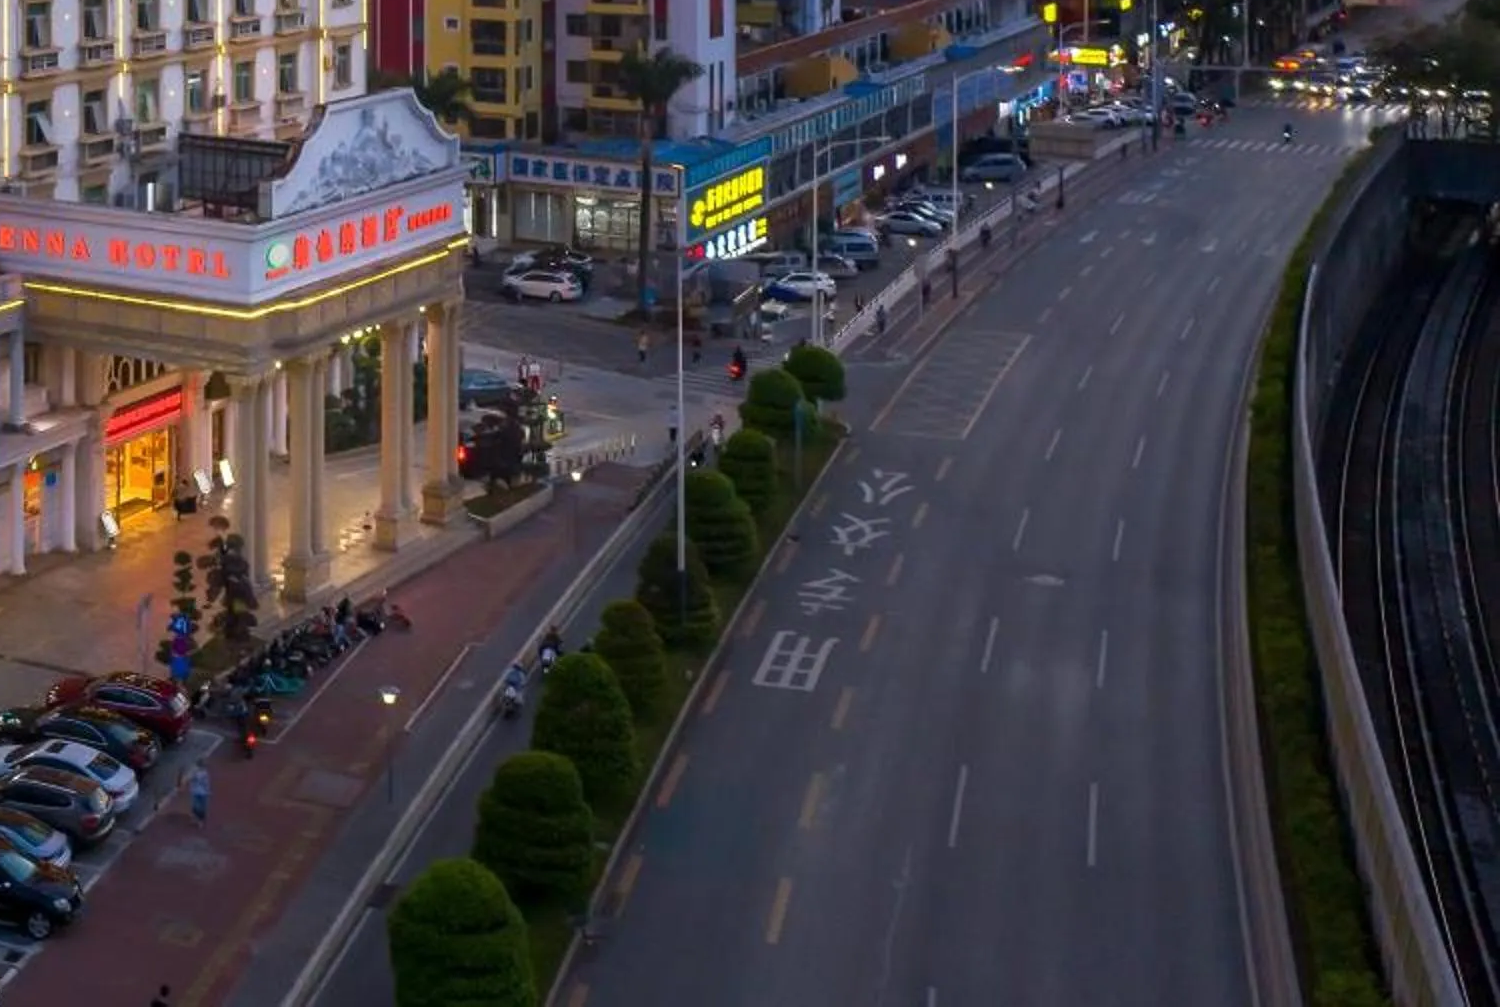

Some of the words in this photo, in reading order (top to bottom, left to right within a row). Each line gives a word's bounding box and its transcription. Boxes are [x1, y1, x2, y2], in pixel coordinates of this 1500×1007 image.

[512, 157, 675, 192] 国家医保定点院
[108, 239, 230, 278] HOTEL
